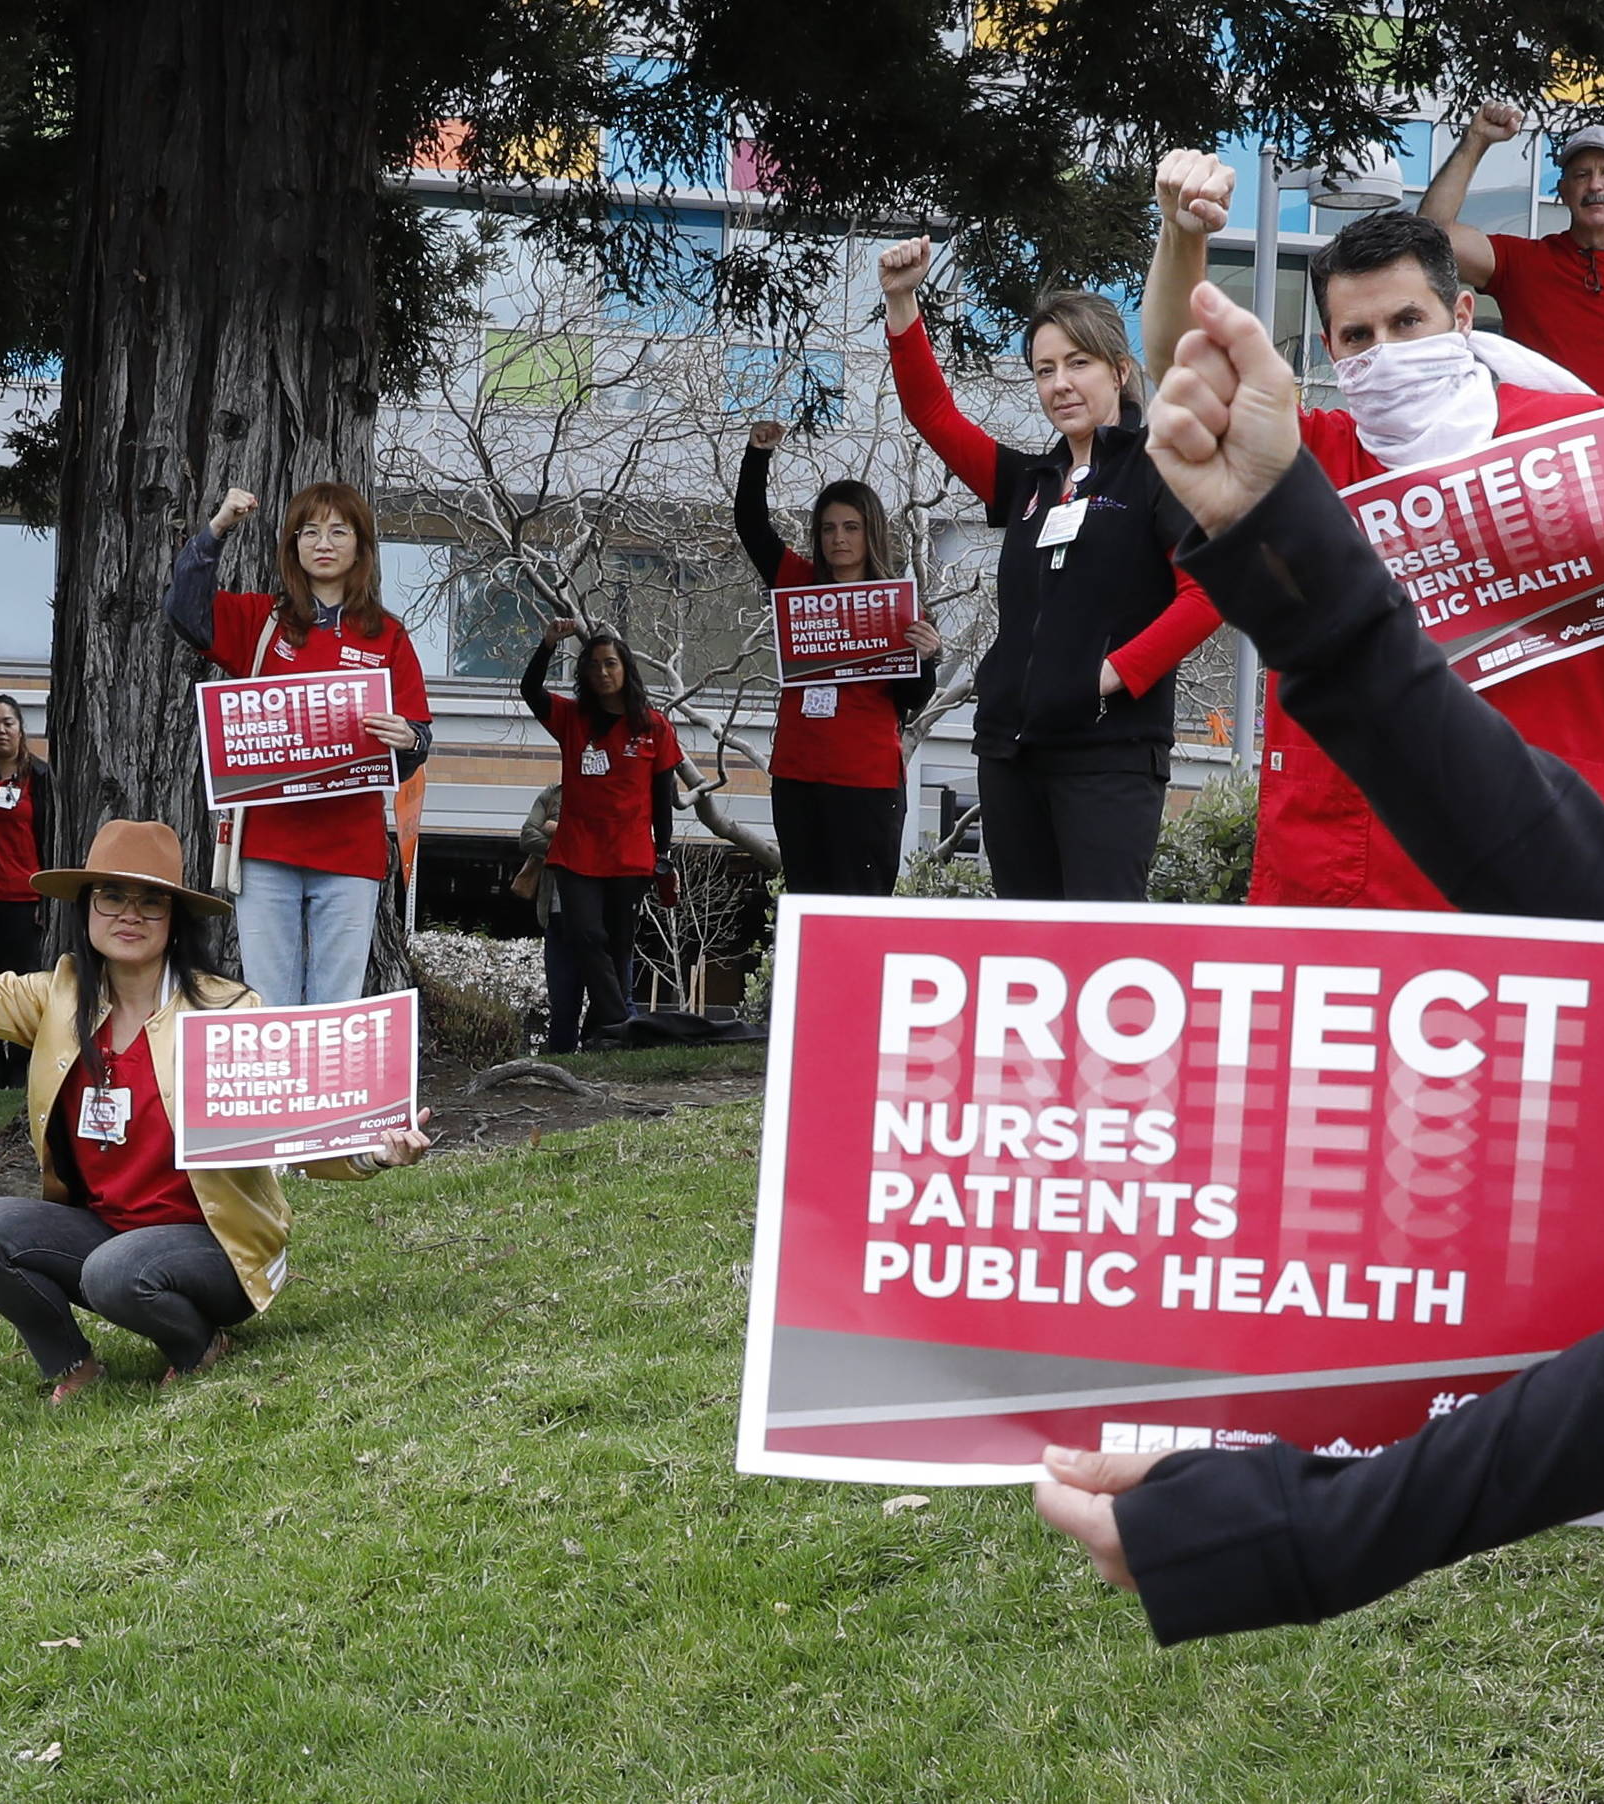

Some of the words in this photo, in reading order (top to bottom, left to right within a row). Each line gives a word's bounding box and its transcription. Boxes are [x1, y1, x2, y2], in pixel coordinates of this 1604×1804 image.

[1352, 434, 1596, 544] ROTECT
[1384, 539, 1460, 579] RSES
[1405, 558, 1495, 602] IENTS
[1418, 592, 1470, 628] LIC
[1474, 556, 1593, 606] HEALTH
[788, 588, 899, 615] PROTECT
[790, 618, 839, 631] NURSES
[791, 629, 850, 643] PATIENTS
[793, 642, 836, 655] PUBLIC
[840, 638, 888, 651] HEALTH
[220, 681, 368, 716] PROTECT
[223, 719, 288, 737] NURSES
[224, 733, 304, 752] PATIENTS
[226, 749, 285, 768] PUBLIC
[289, 743, 353, 762] HEALTH
[349, 765, 389, 774] #COVID19
[205, 1008, 392, 1052] PROTECT
[878, 951, 1590, 1083] PROTECT
[206, 1060, 291, 1079] NURSES
[206, 1078, 308, 1098] PATIENTS
[206, 1098, 282, 1117] PUBLIC
[288, 1089, 368, 1113] HEALTH
[359, 1112, 407, 1129] #COVID19
[871, 1098, 1177, 1165] NURSES
[868, 1169, 1239, 1240] PATIENTS
[862, 1240, 1137, 1308] PUBLIC
[1160, 1254, 1467, 1327] HEALTH
[1215, 1428, 1278, 1444] Californi
